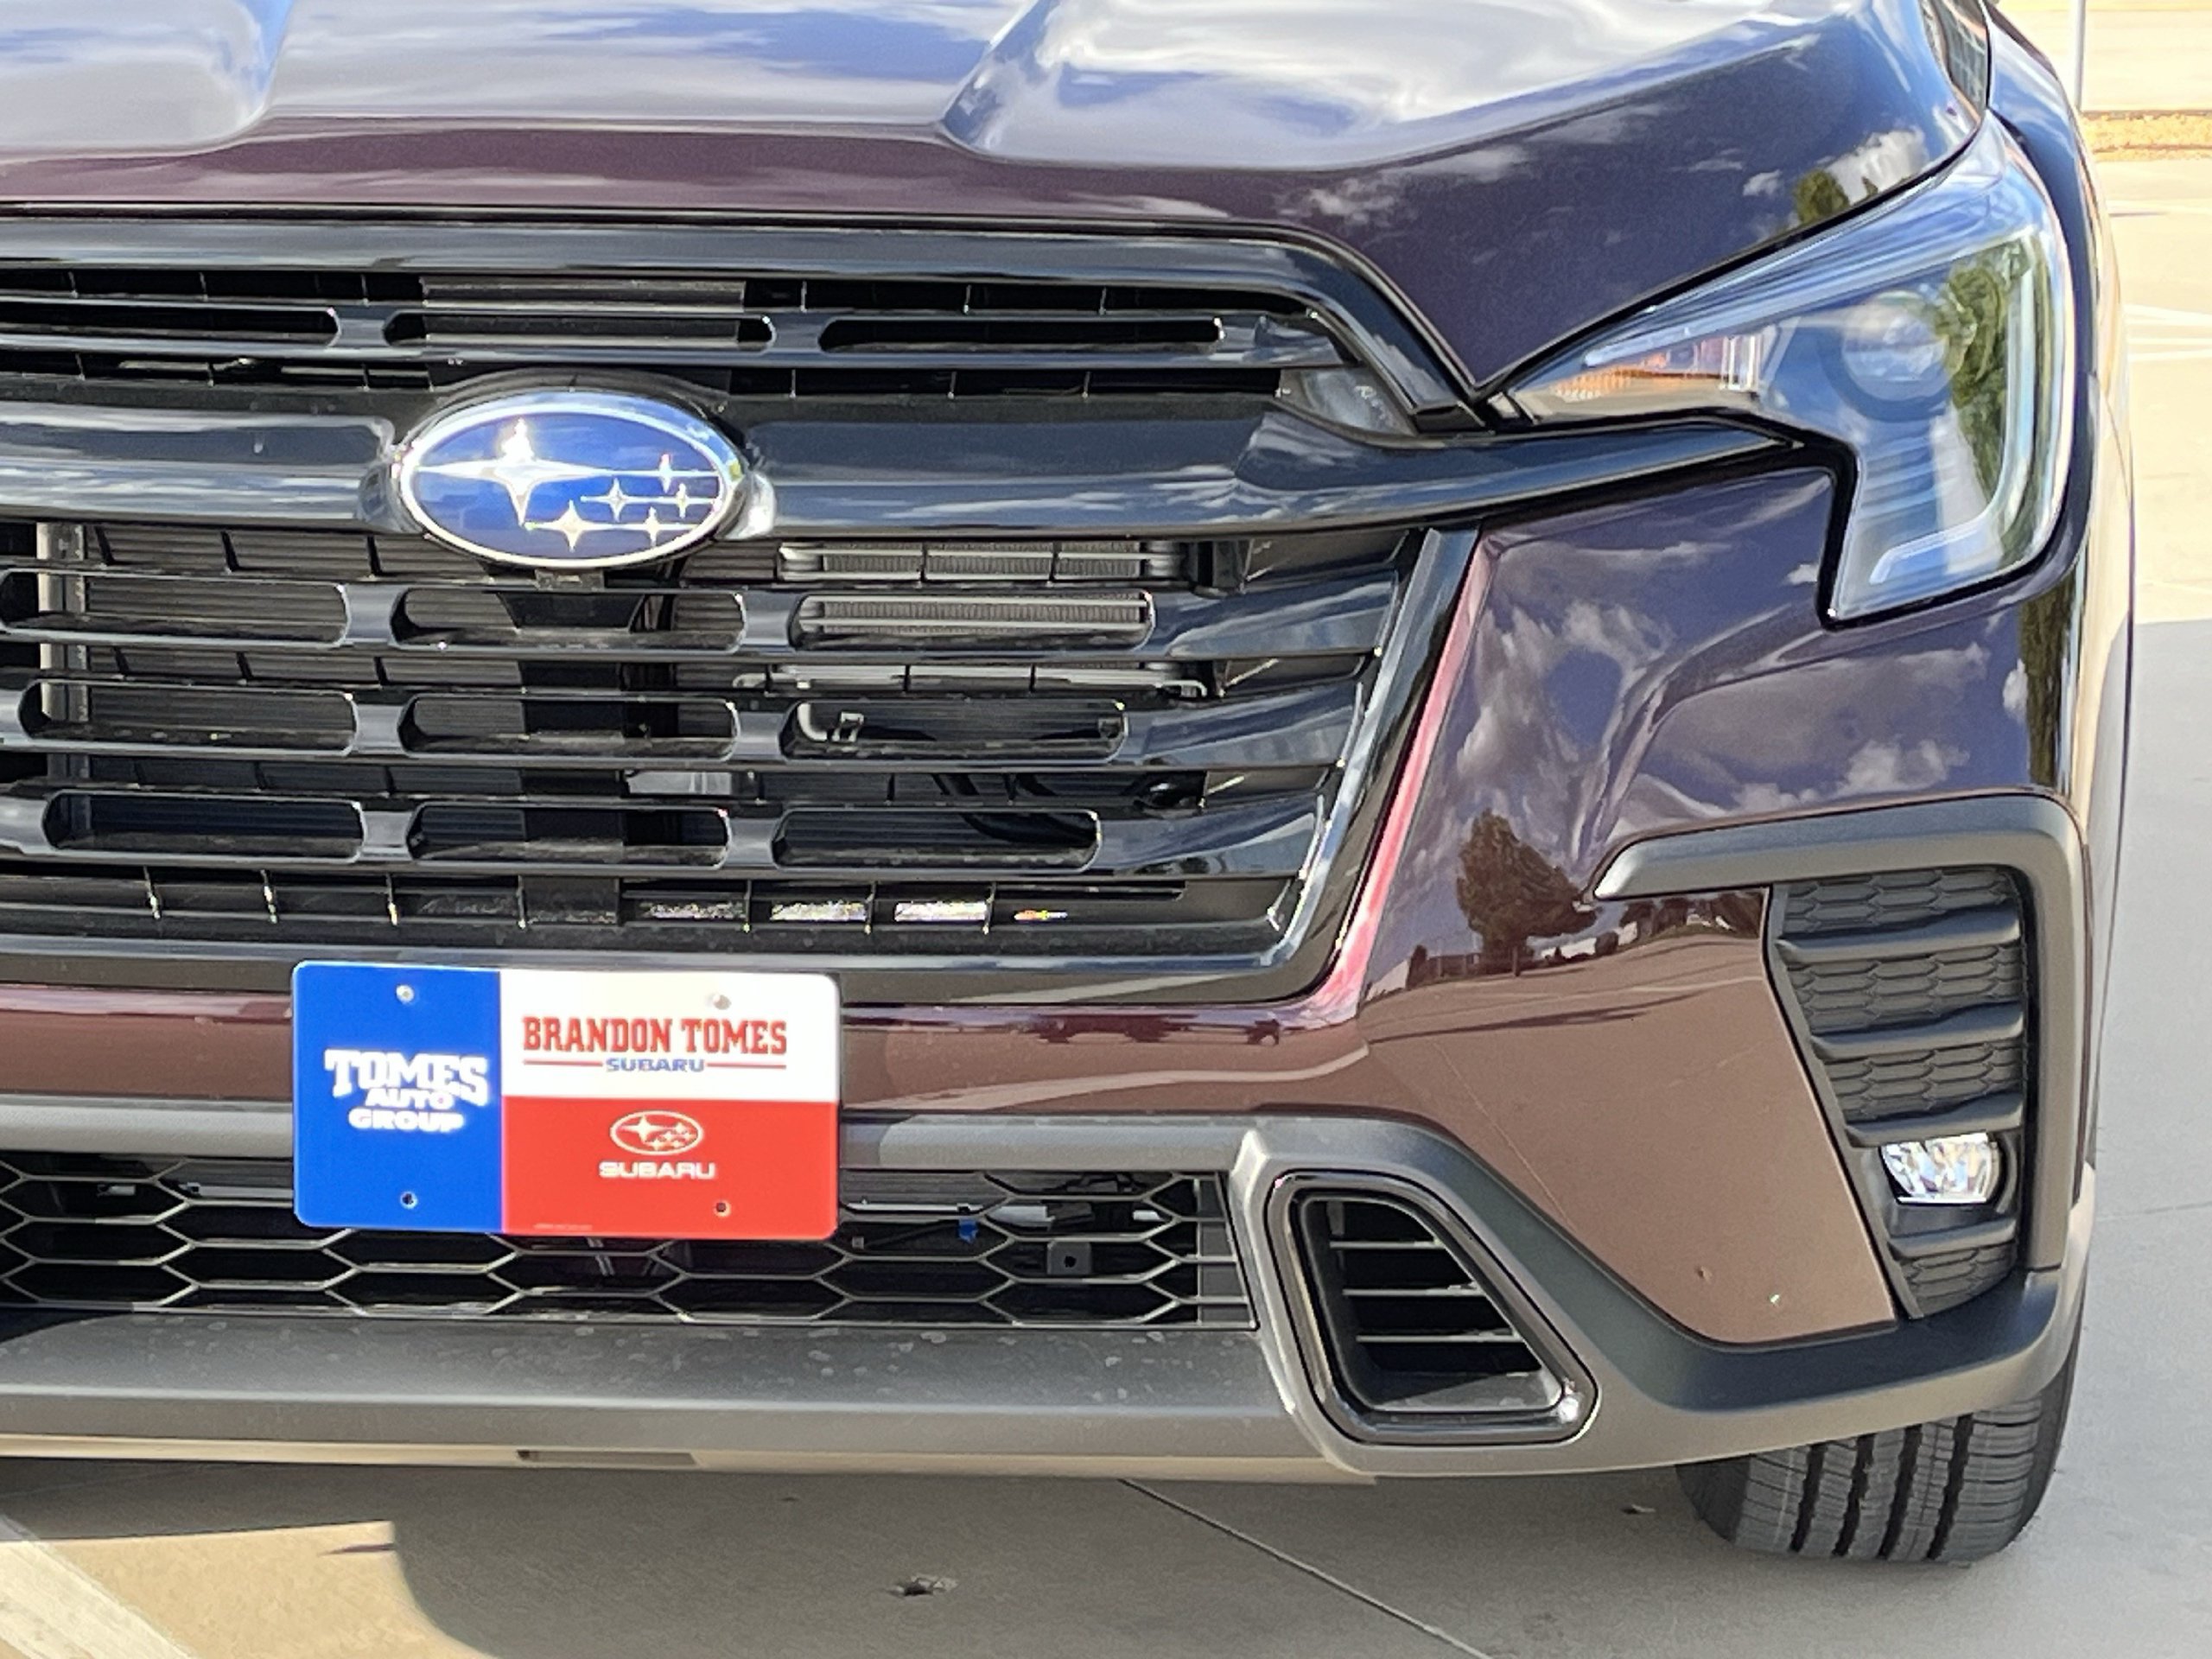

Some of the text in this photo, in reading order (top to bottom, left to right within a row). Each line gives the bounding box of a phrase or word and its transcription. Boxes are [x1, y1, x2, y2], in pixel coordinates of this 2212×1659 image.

[522, 1016, 788, 1055] BRANDON TOMES
[606, 1058, 706, 1072] SUBARU
[324, 1049, 488, 1107] TOMES
[365, 1088, 454, 1110] AUTO
[348, 1109, 465, 1133] GROUP
[599, 1160, 716, 1179] SUBARU
